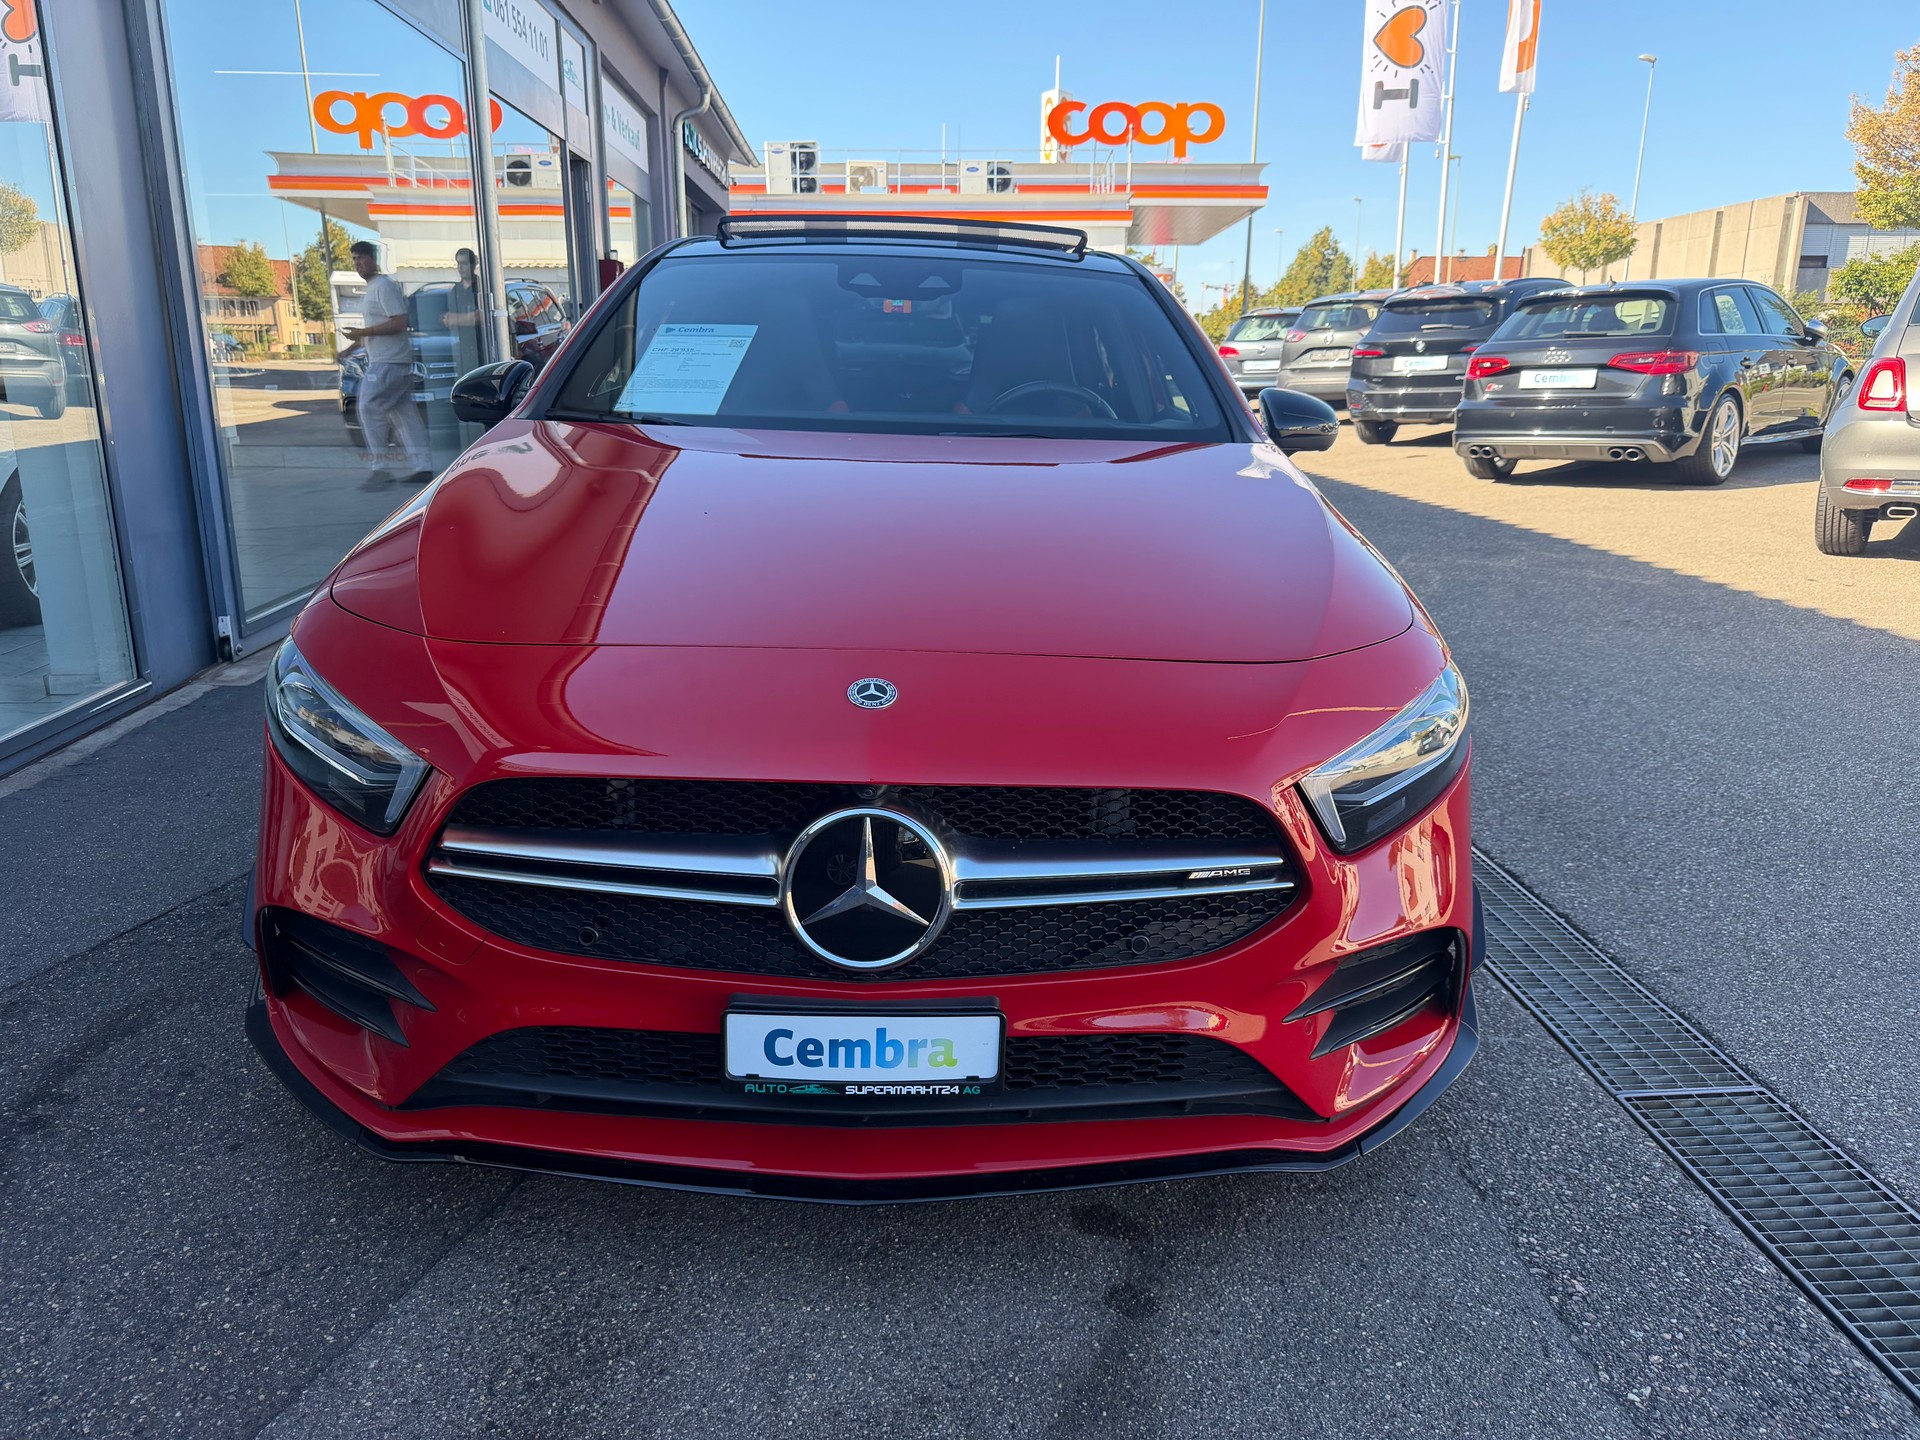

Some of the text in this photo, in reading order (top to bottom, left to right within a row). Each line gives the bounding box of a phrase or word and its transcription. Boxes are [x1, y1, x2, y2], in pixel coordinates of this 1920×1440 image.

[511, 4, 528, 43] 554
[529, 21, 539, 53] 11
[540, 31, 549, 62] 01
[1048, 100, 1226, 157] coop
[1209, 868, 1251, 878] AMG
[763, 1027, 958, 1069] Cembra
[745, 1083, 787, 1094] AUTO
[963, 1085, 981, 1095] AG
